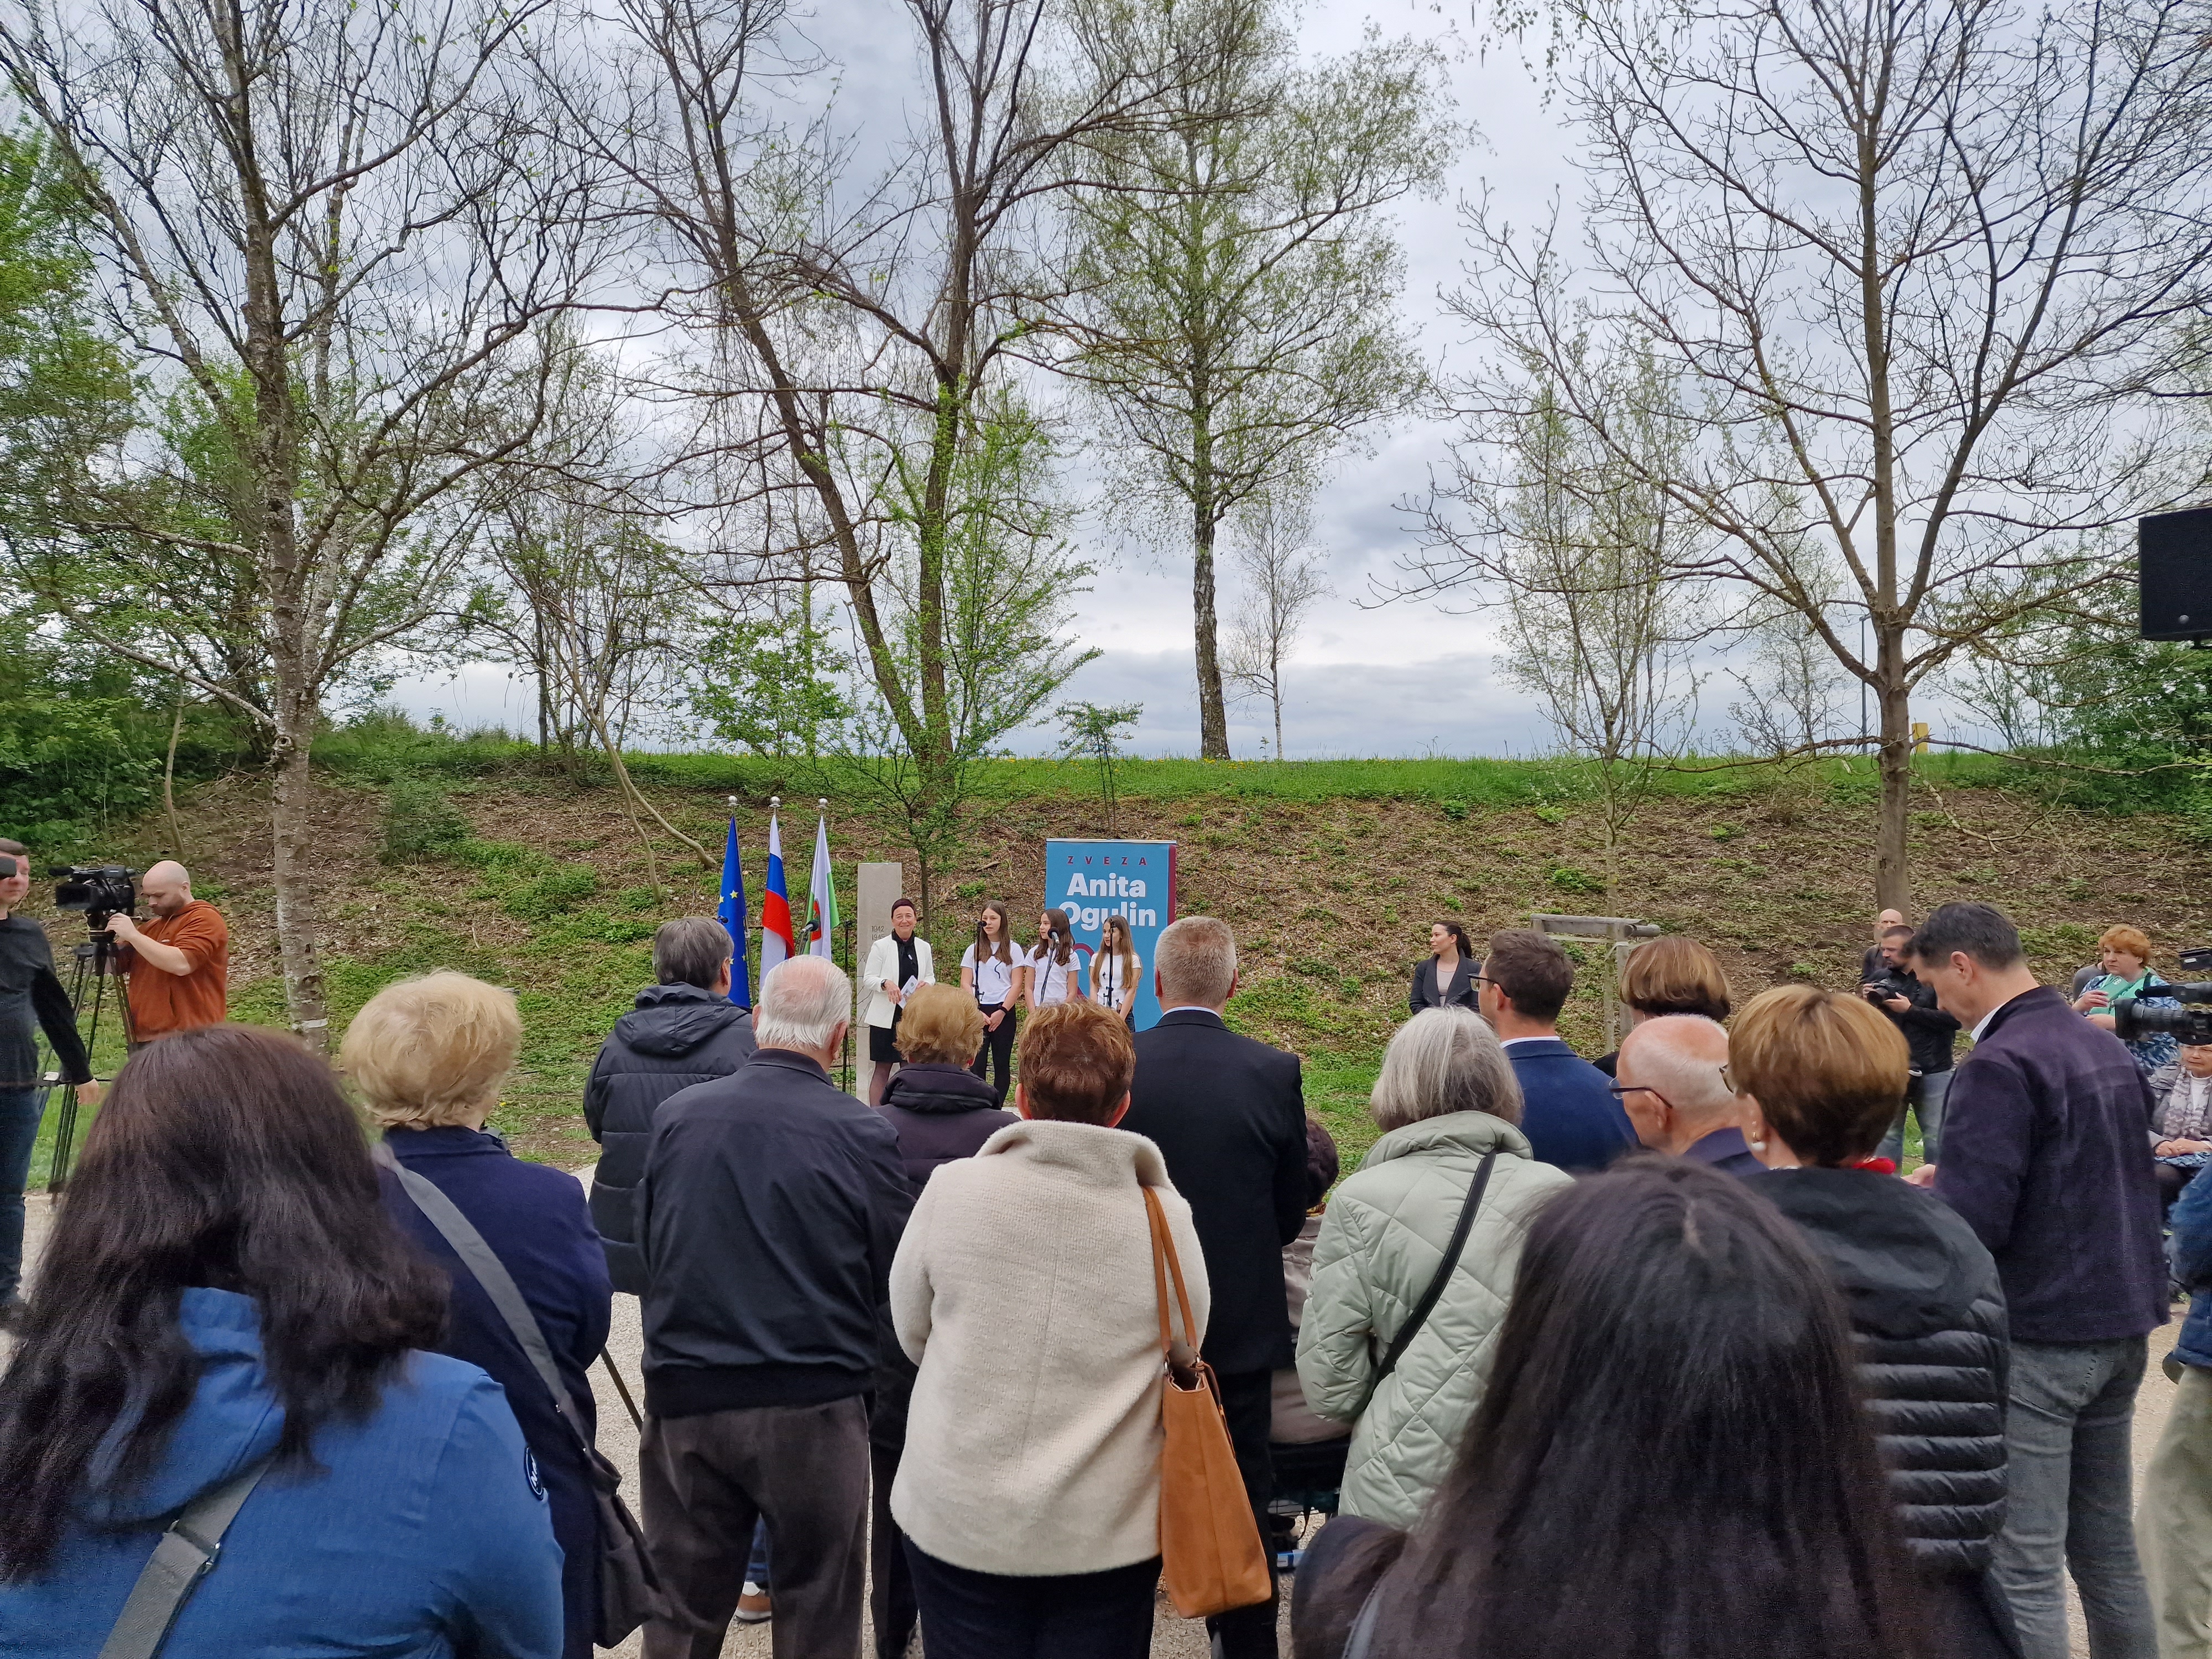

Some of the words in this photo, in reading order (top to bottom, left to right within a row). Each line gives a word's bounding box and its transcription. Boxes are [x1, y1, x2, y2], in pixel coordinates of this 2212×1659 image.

[1067, 855, 1147, 866] ZVEZA
[1066, 872, 1146, 898] Anita
[1058, 901, 1156, 931] Ogulin
